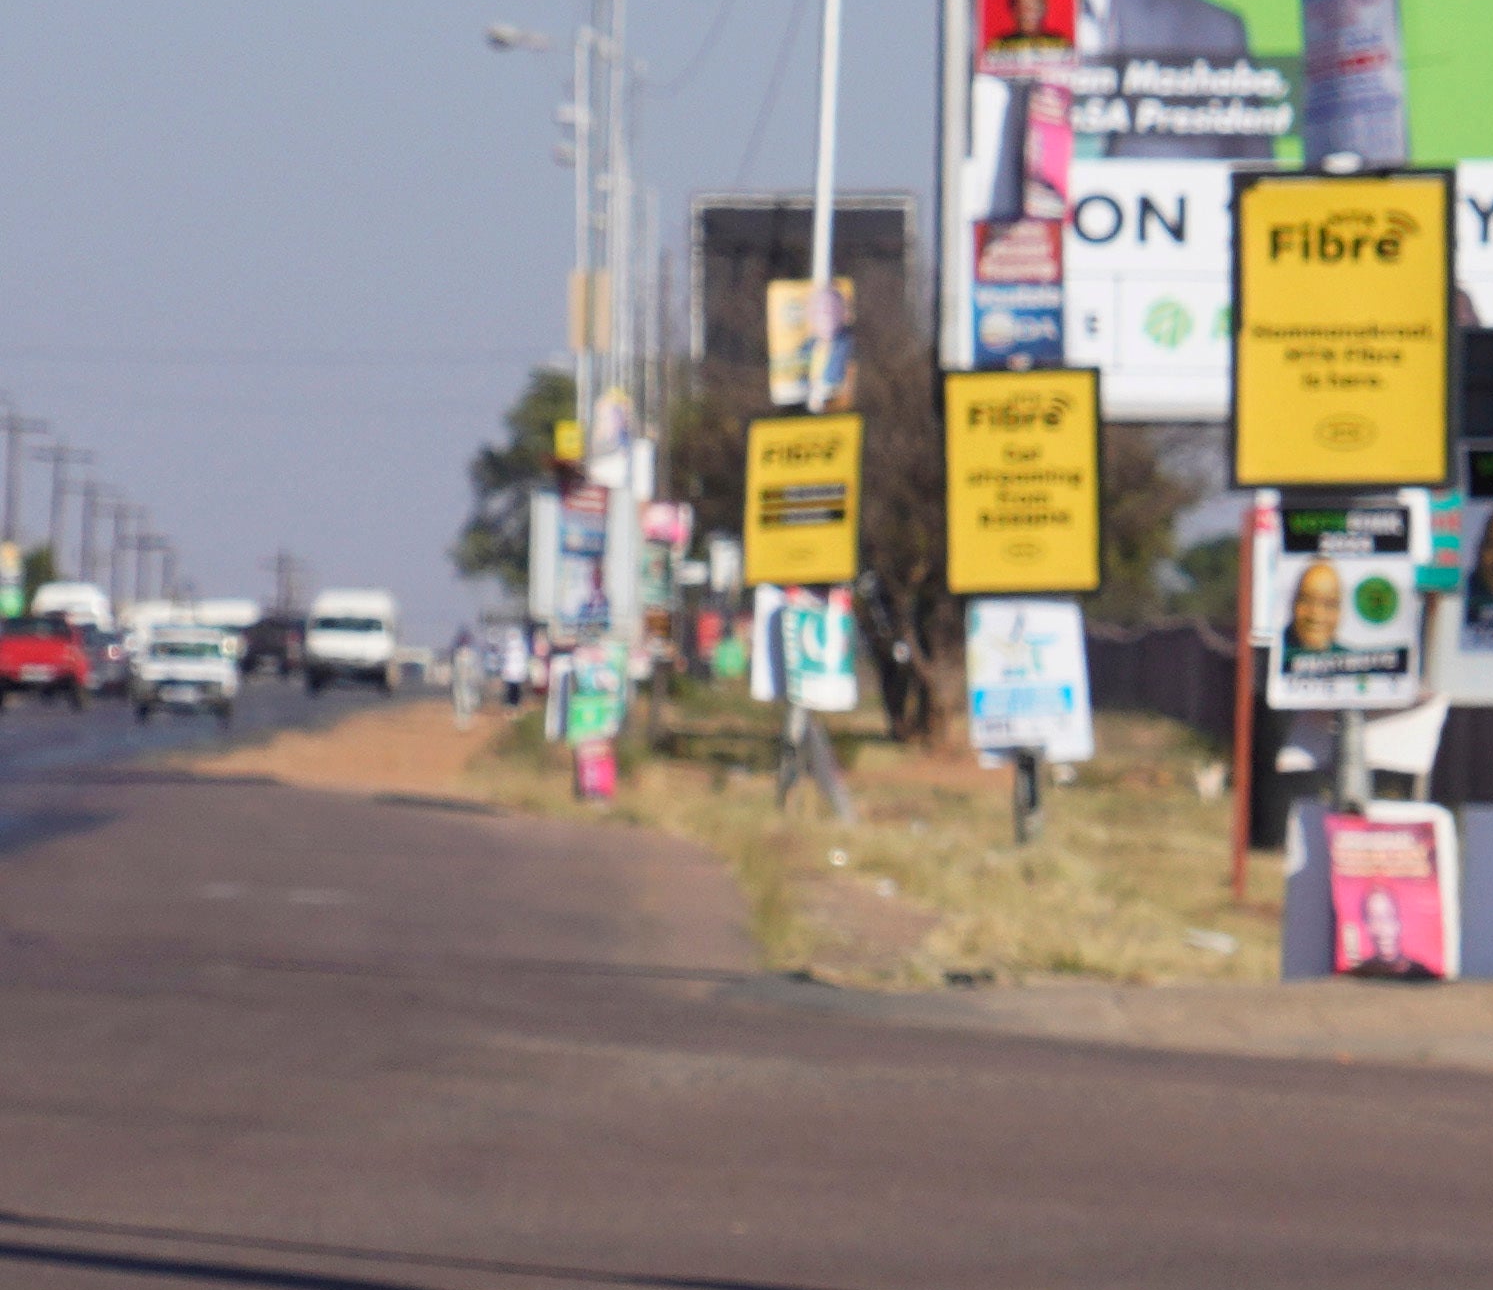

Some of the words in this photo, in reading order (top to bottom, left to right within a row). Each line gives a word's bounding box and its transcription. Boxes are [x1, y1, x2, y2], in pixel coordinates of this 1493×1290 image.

[1134, 96, 1294, 136] President
[1074, 194, 1187, 244] ON
[1268, 222, 1402, 263] Fibre
